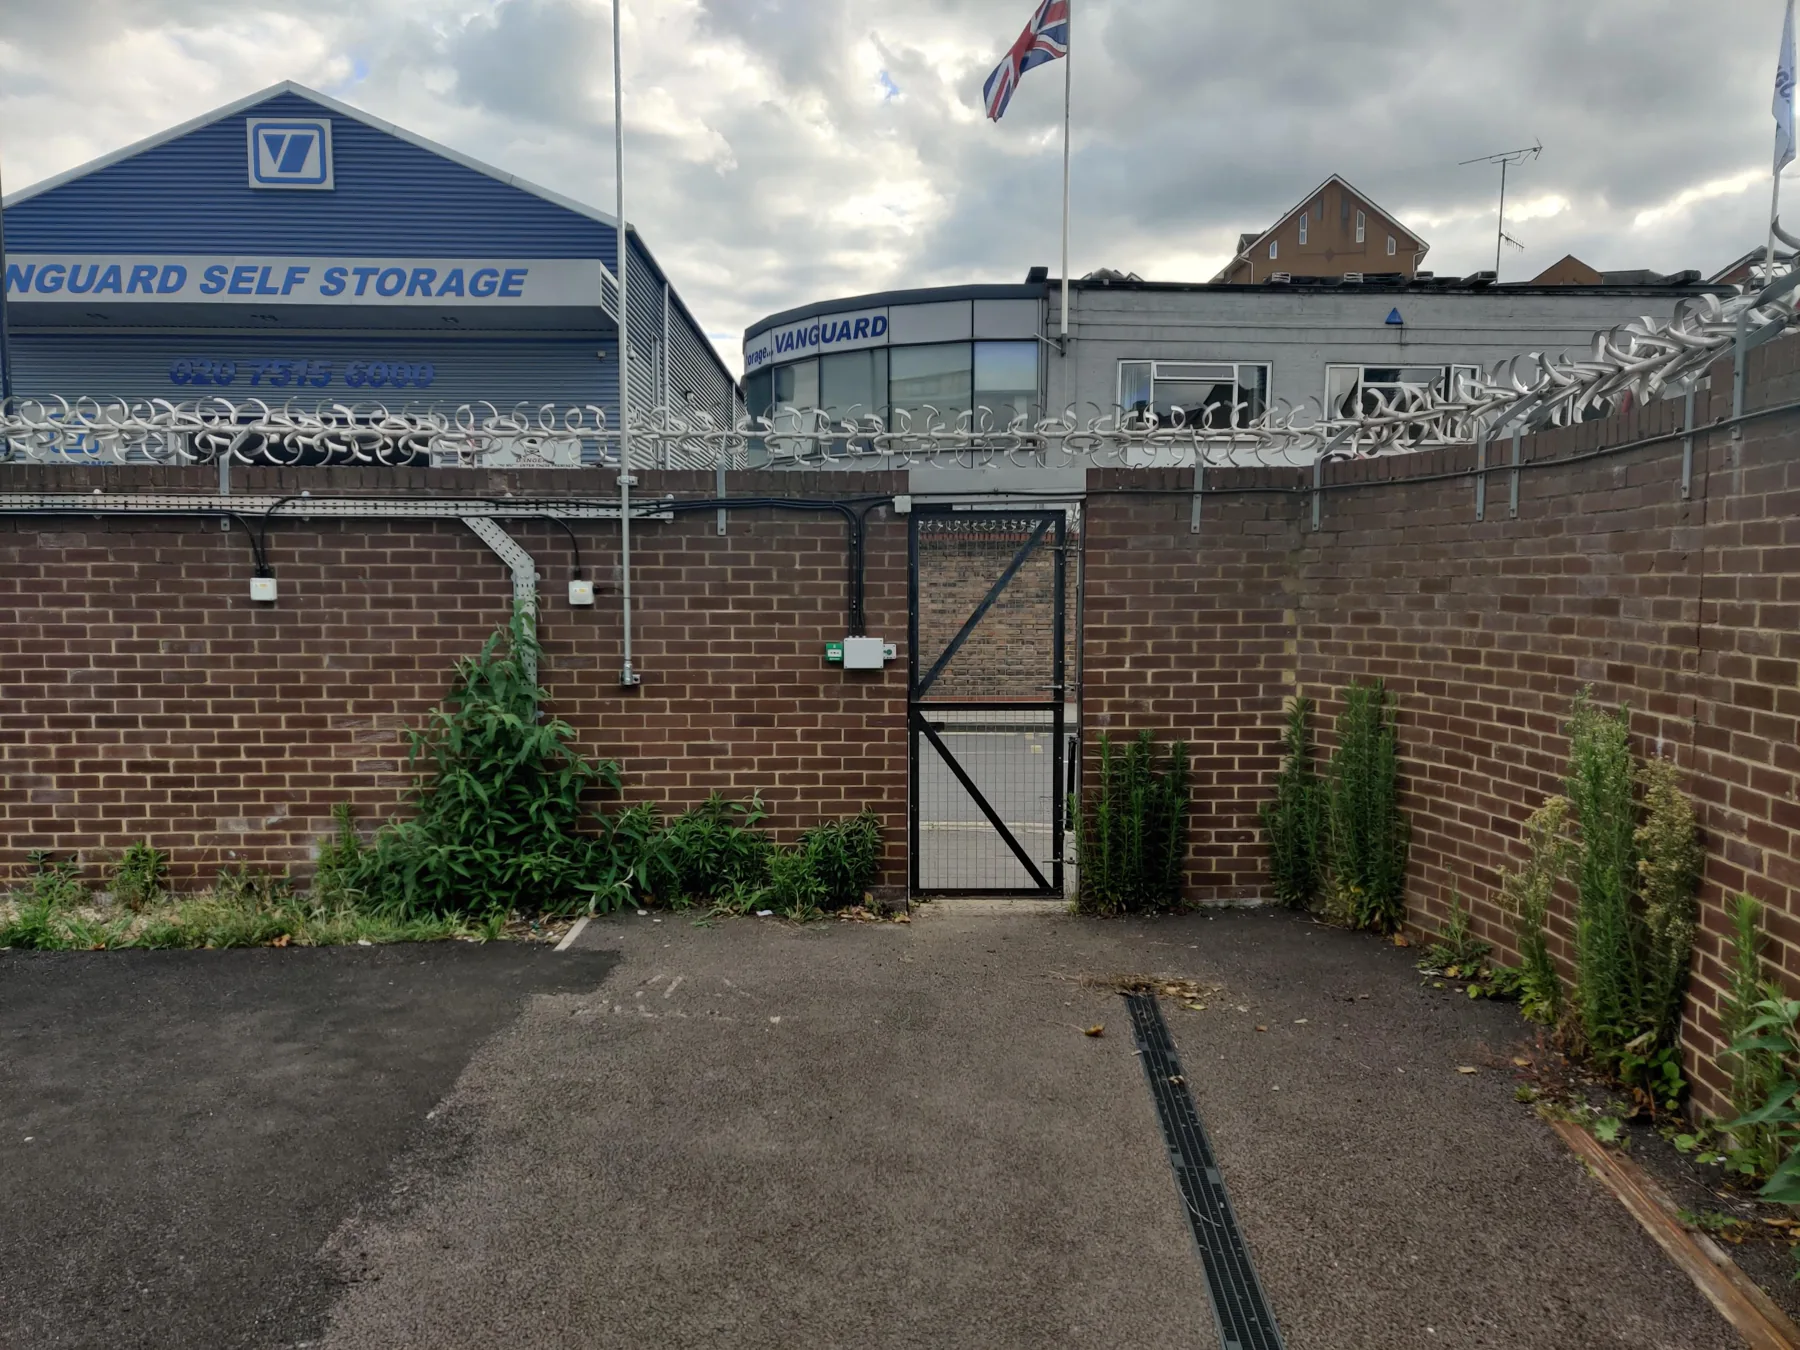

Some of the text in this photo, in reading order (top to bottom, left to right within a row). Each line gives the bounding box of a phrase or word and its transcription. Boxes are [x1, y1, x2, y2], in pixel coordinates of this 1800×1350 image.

[200, 265, 311, 295] SELF
[319, 267, 529, 298] STORAGE
[775, 315, 888, 353] VANGUARD
[169, 358, 435, 388] 020 7515 6000
